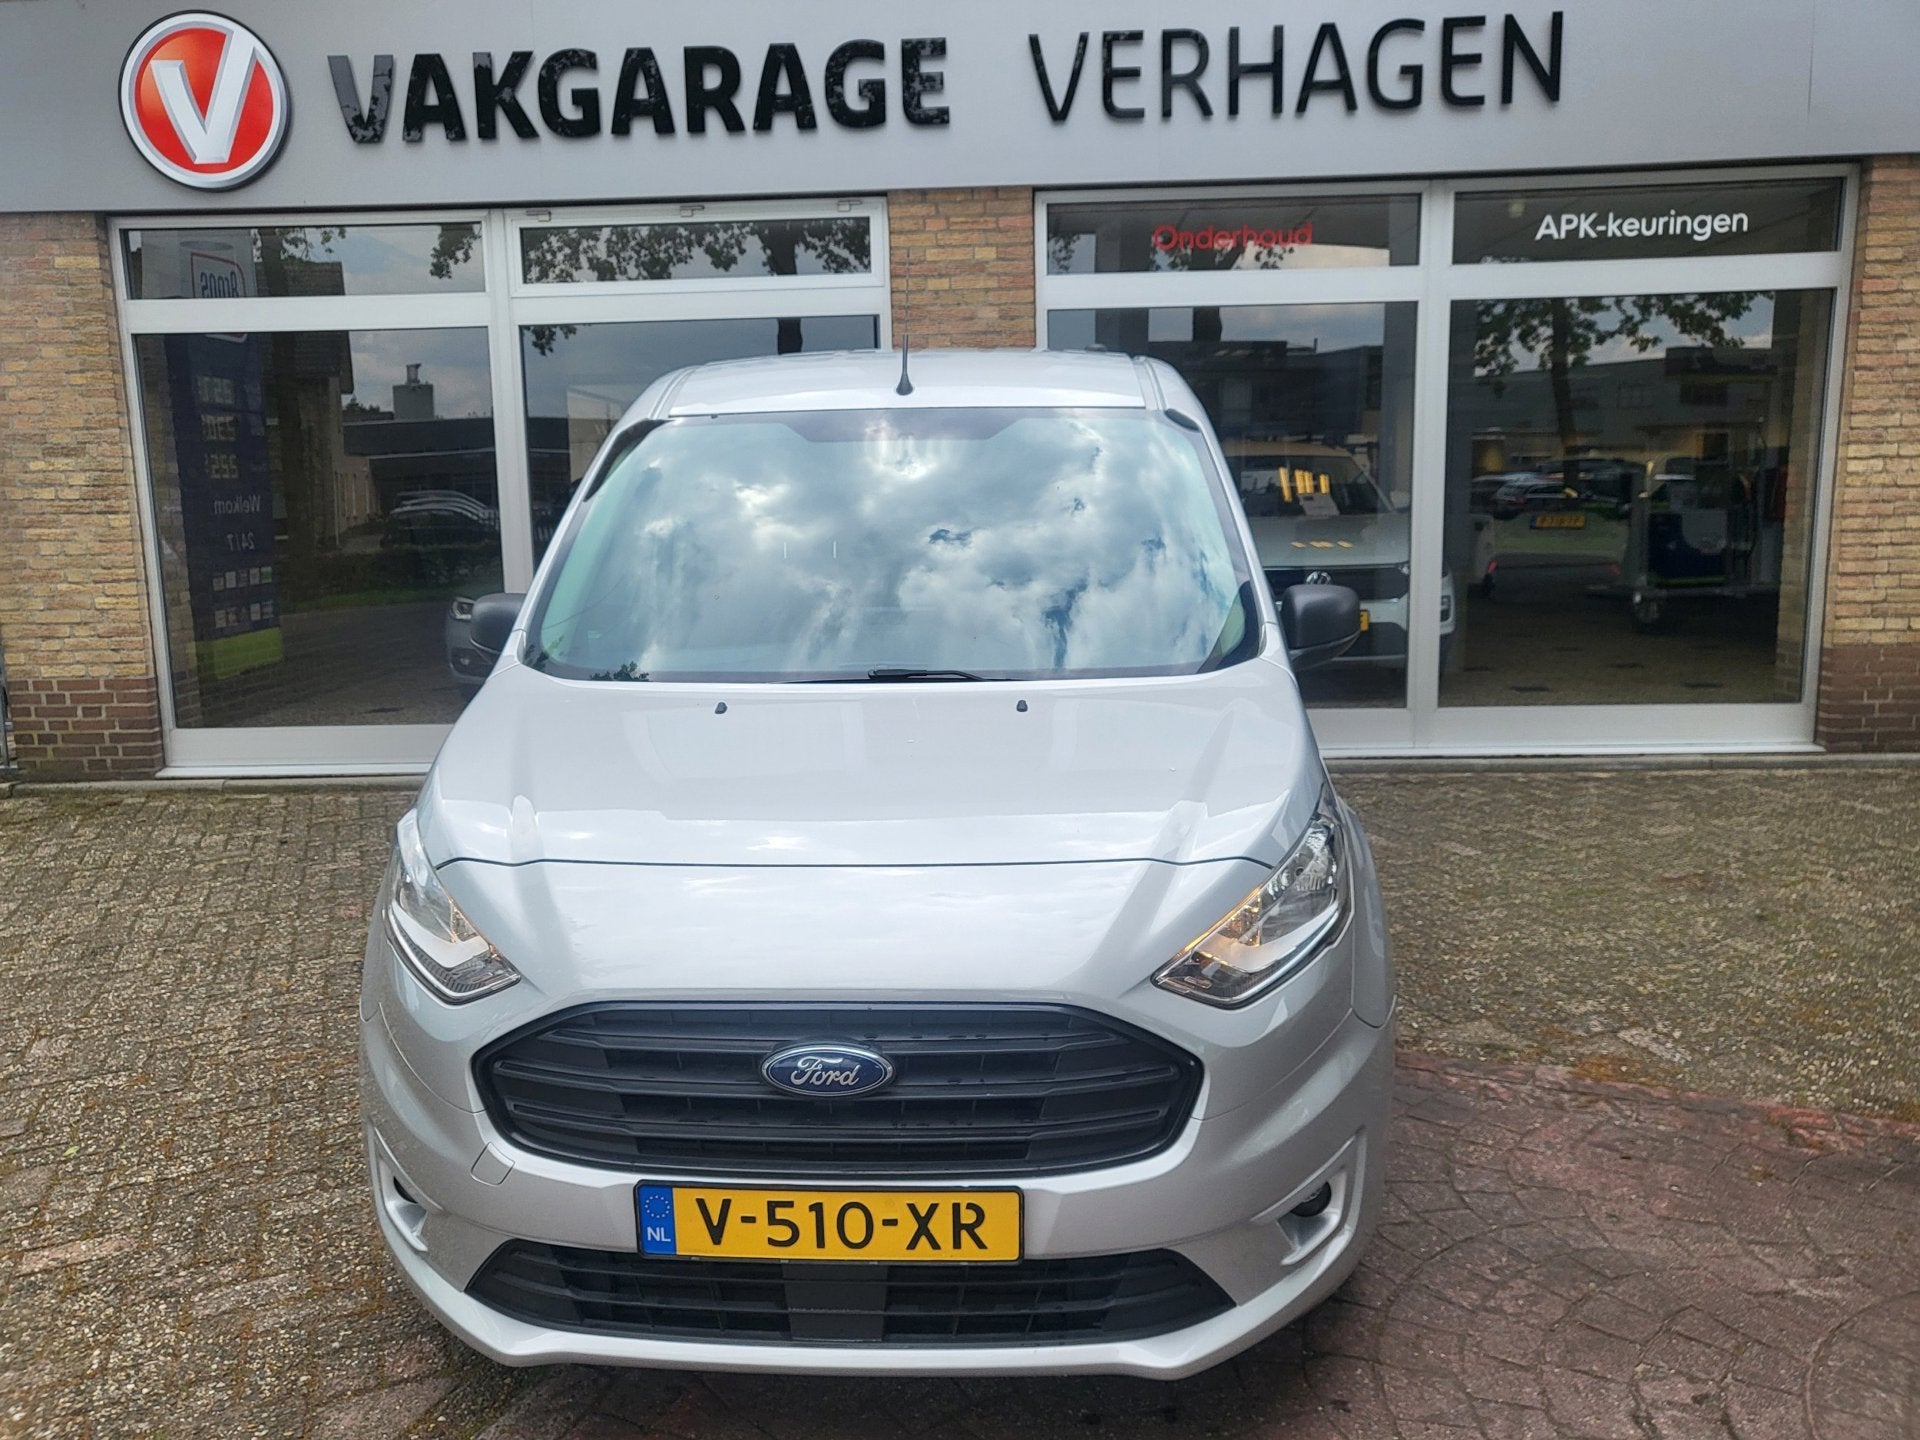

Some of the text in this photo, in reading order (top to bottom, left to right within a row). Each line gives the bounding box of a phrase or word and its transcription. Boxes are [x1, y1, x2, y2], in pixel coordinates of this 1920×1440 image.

[326, 11, 1563, 144] VAKGARAGE VERHAGEN
[1152, 220, 1313, 250] Onderhoud
[1535, 209, 1749, 242] APK-keuringen
[789, 1055, 860, 1087] Ford
[646, 1226, 671, 1243] NL
[695, 1197, 989, 1251] V-510-XR
